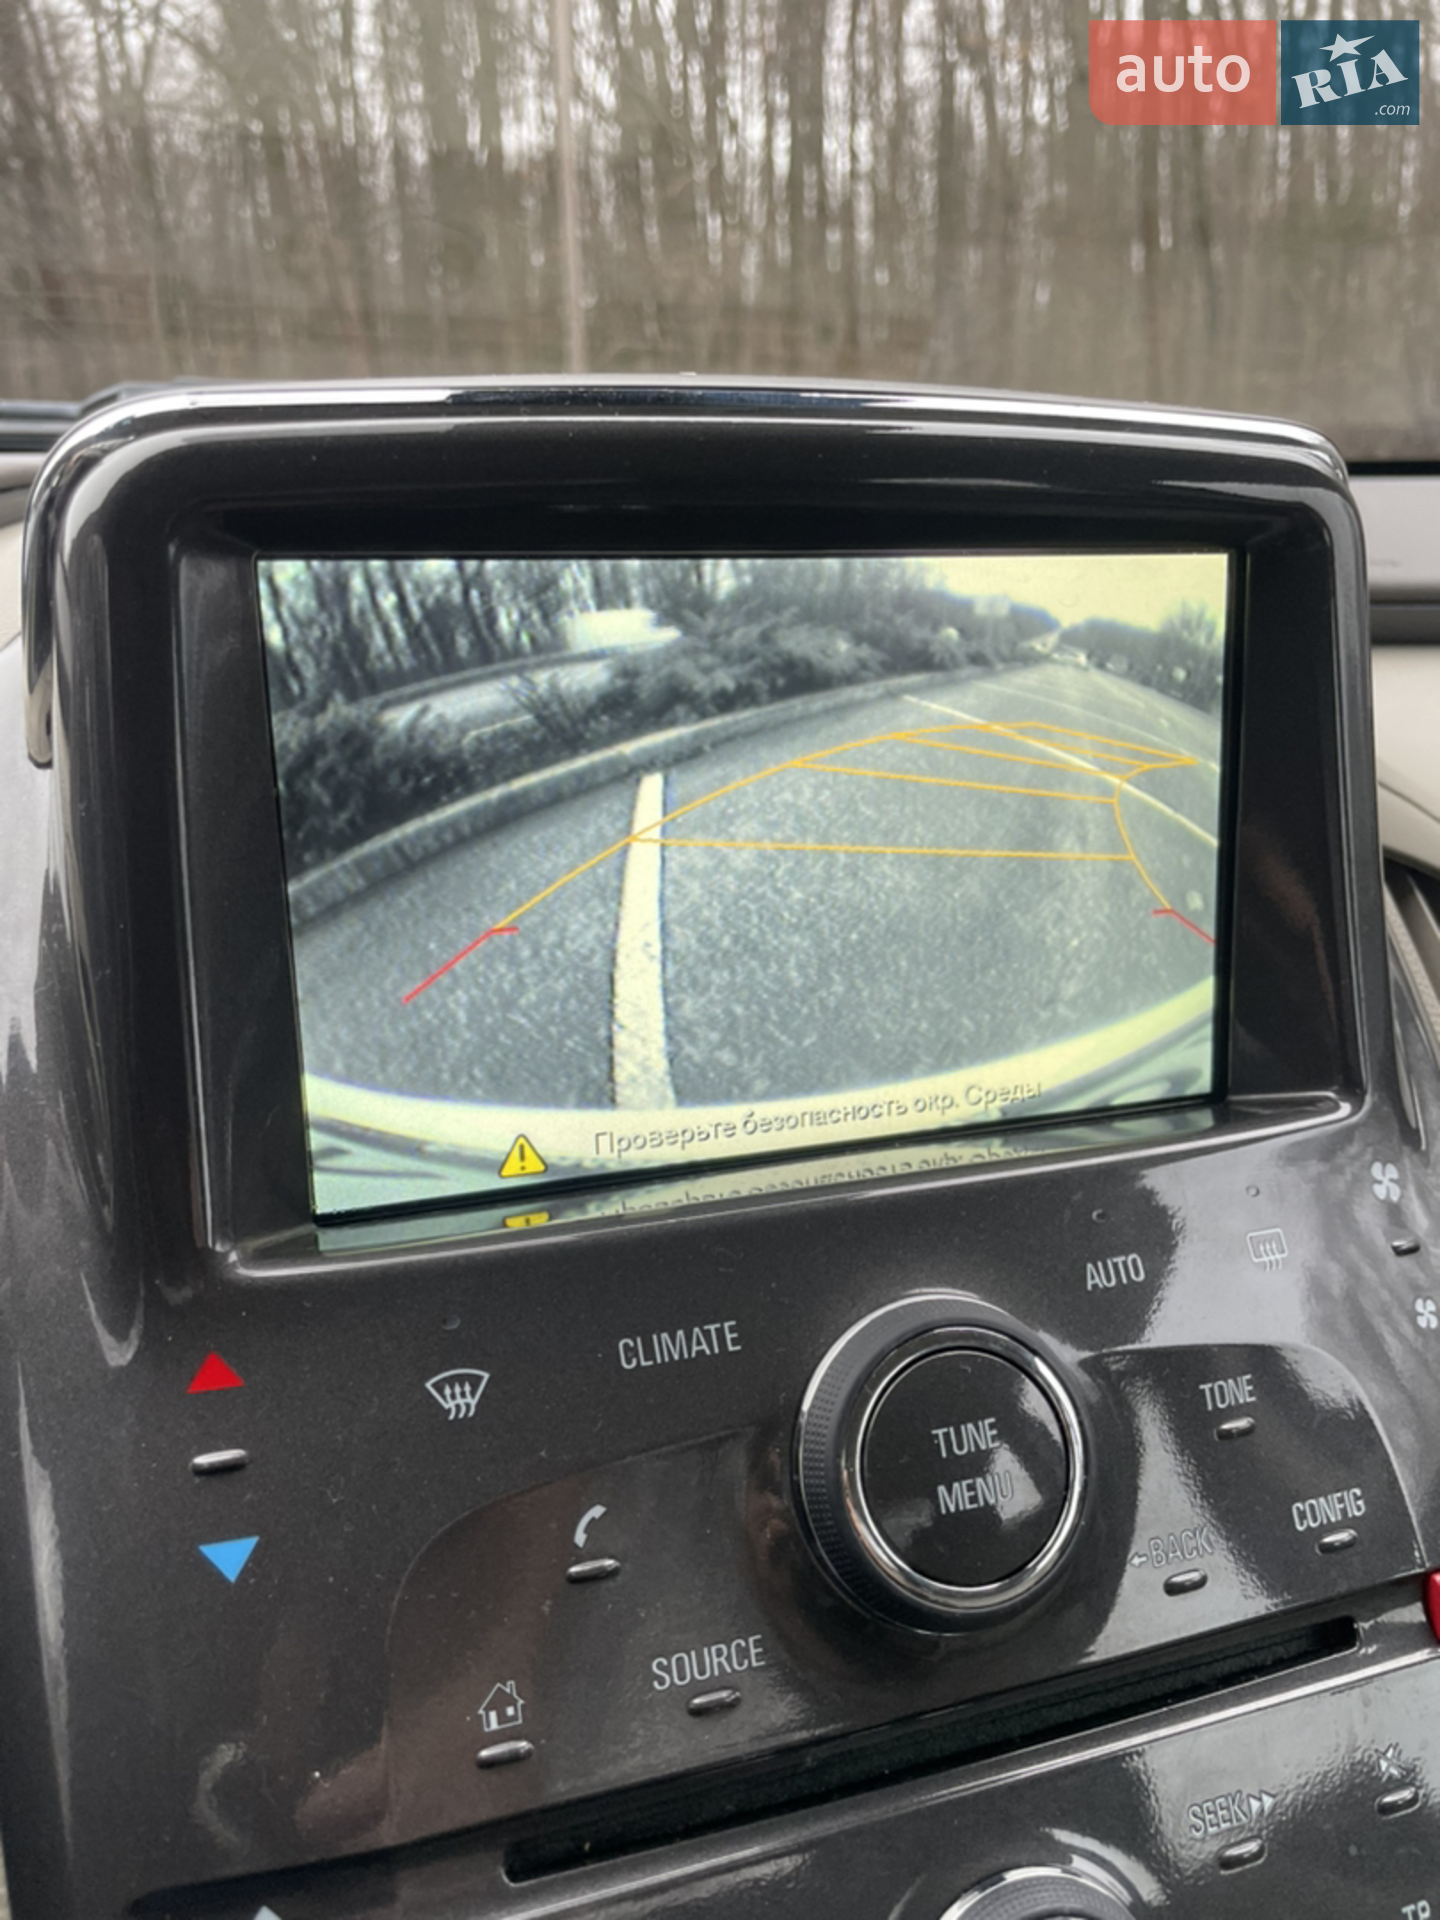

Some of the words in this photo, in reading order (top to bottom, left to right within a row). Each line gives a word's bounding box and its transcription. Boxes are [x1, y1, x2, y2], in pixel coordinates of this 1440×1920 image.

[594, 1120, 737, 1160] Проверьте
[742, 1099, 908, 1136] безопасность
[914, 1092, 959, 1115] окр.
[965, 1082, 1042, 1110] Среды
[1086, 1253, 1145, 1291] AUTO
[618, 1320, 741, 1370] CLIMATE
[1199, 1374, 1256, 1411] TONE
[931, 1417, 999, 1458] TUNE
[937, 1471, 1014, 1515] MENU
[1292, 1488, 1366, 1531] CONFIG
[1149, 1527, 1213, 1568] BACK
[651, 1635, 766, 1690] SOURCE
[1188, 1790, 1248, 1836] SEEK
